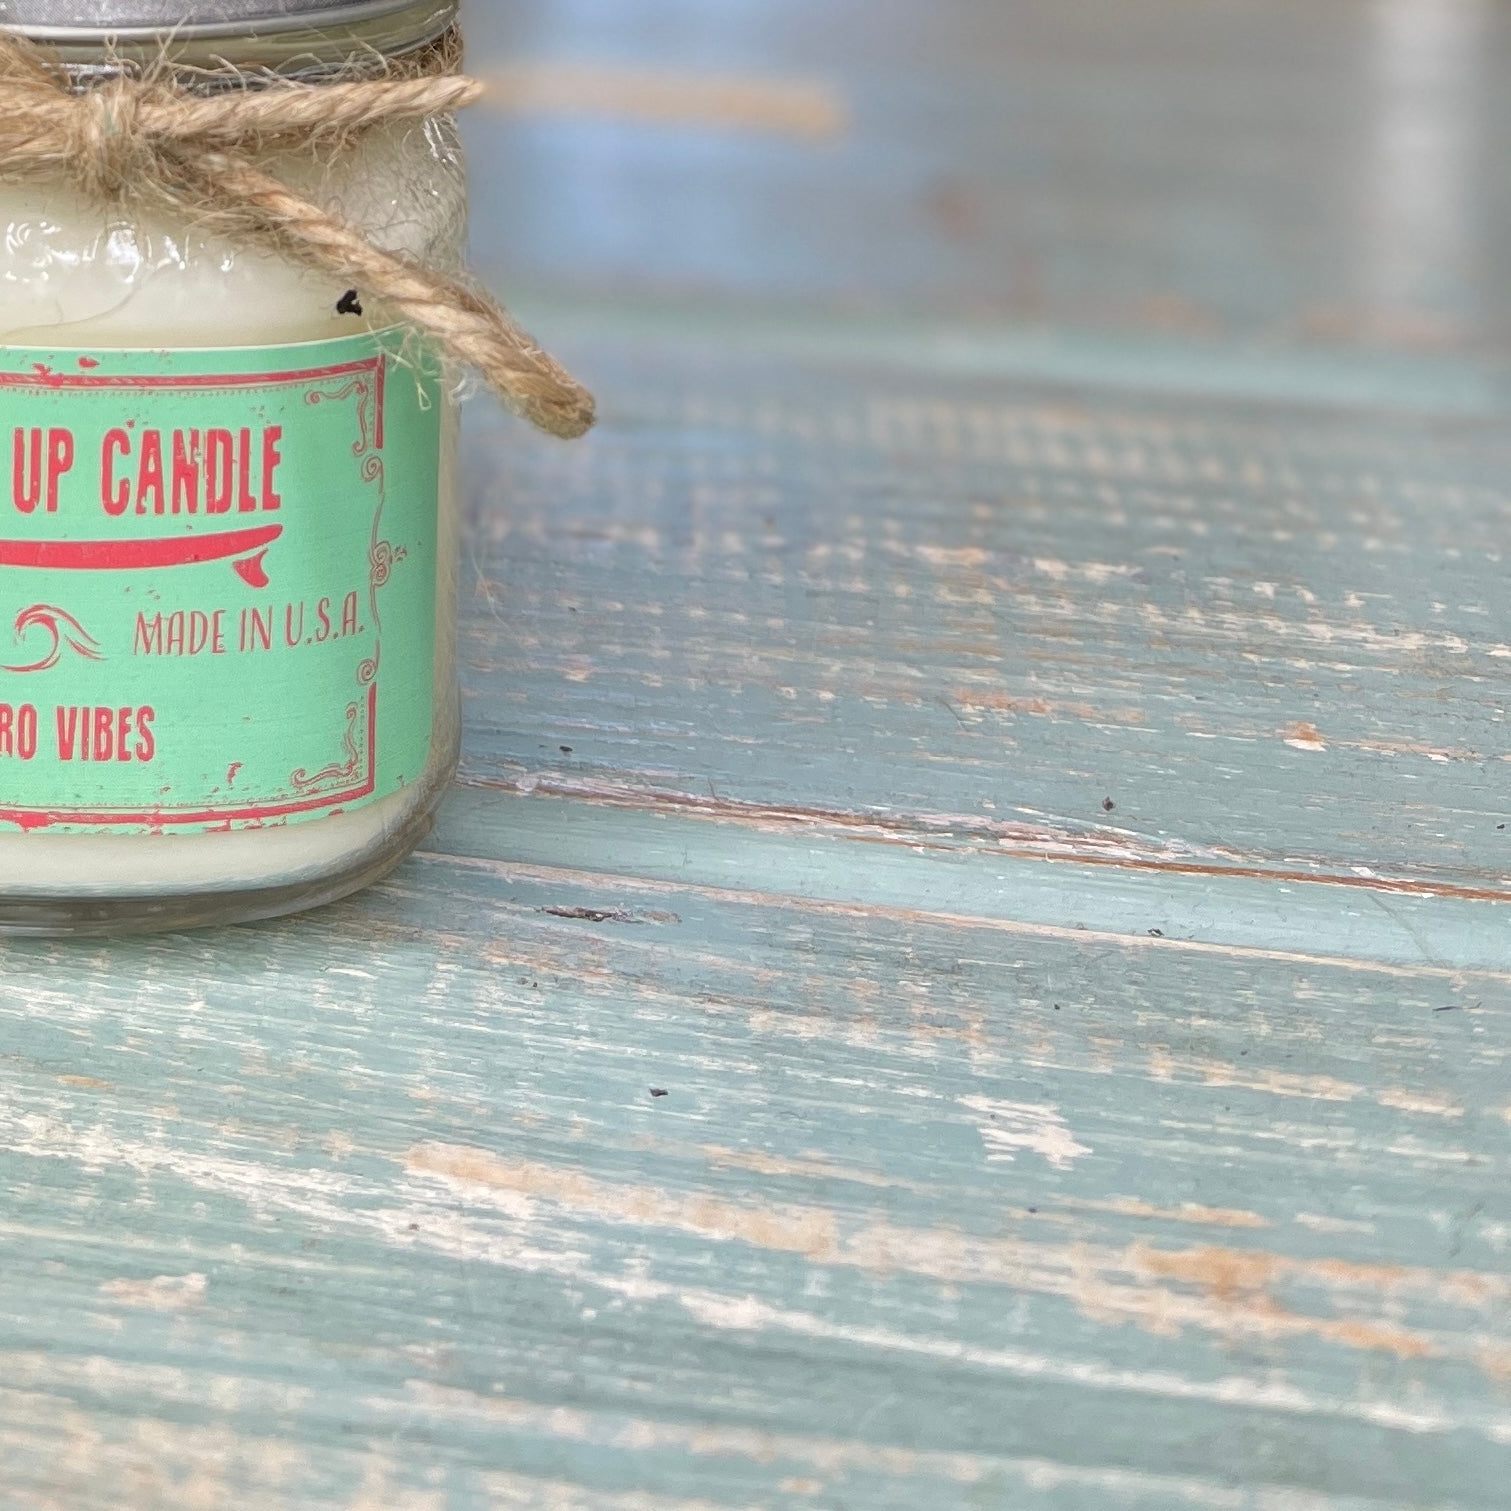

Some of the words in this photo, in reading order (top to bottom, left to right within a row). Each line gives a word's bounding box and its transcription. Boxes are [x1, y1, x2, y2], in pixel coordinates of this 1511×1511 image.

[12, 427, 74, 513] UP
[100, 425, 283, 516] CANDLE
[132, 609, 226, 657] MADE
[238, 606, 273, 653] IN
[284, 591, 366, 646] U.S.A.
[56, 704, 156, 762] VIBES
